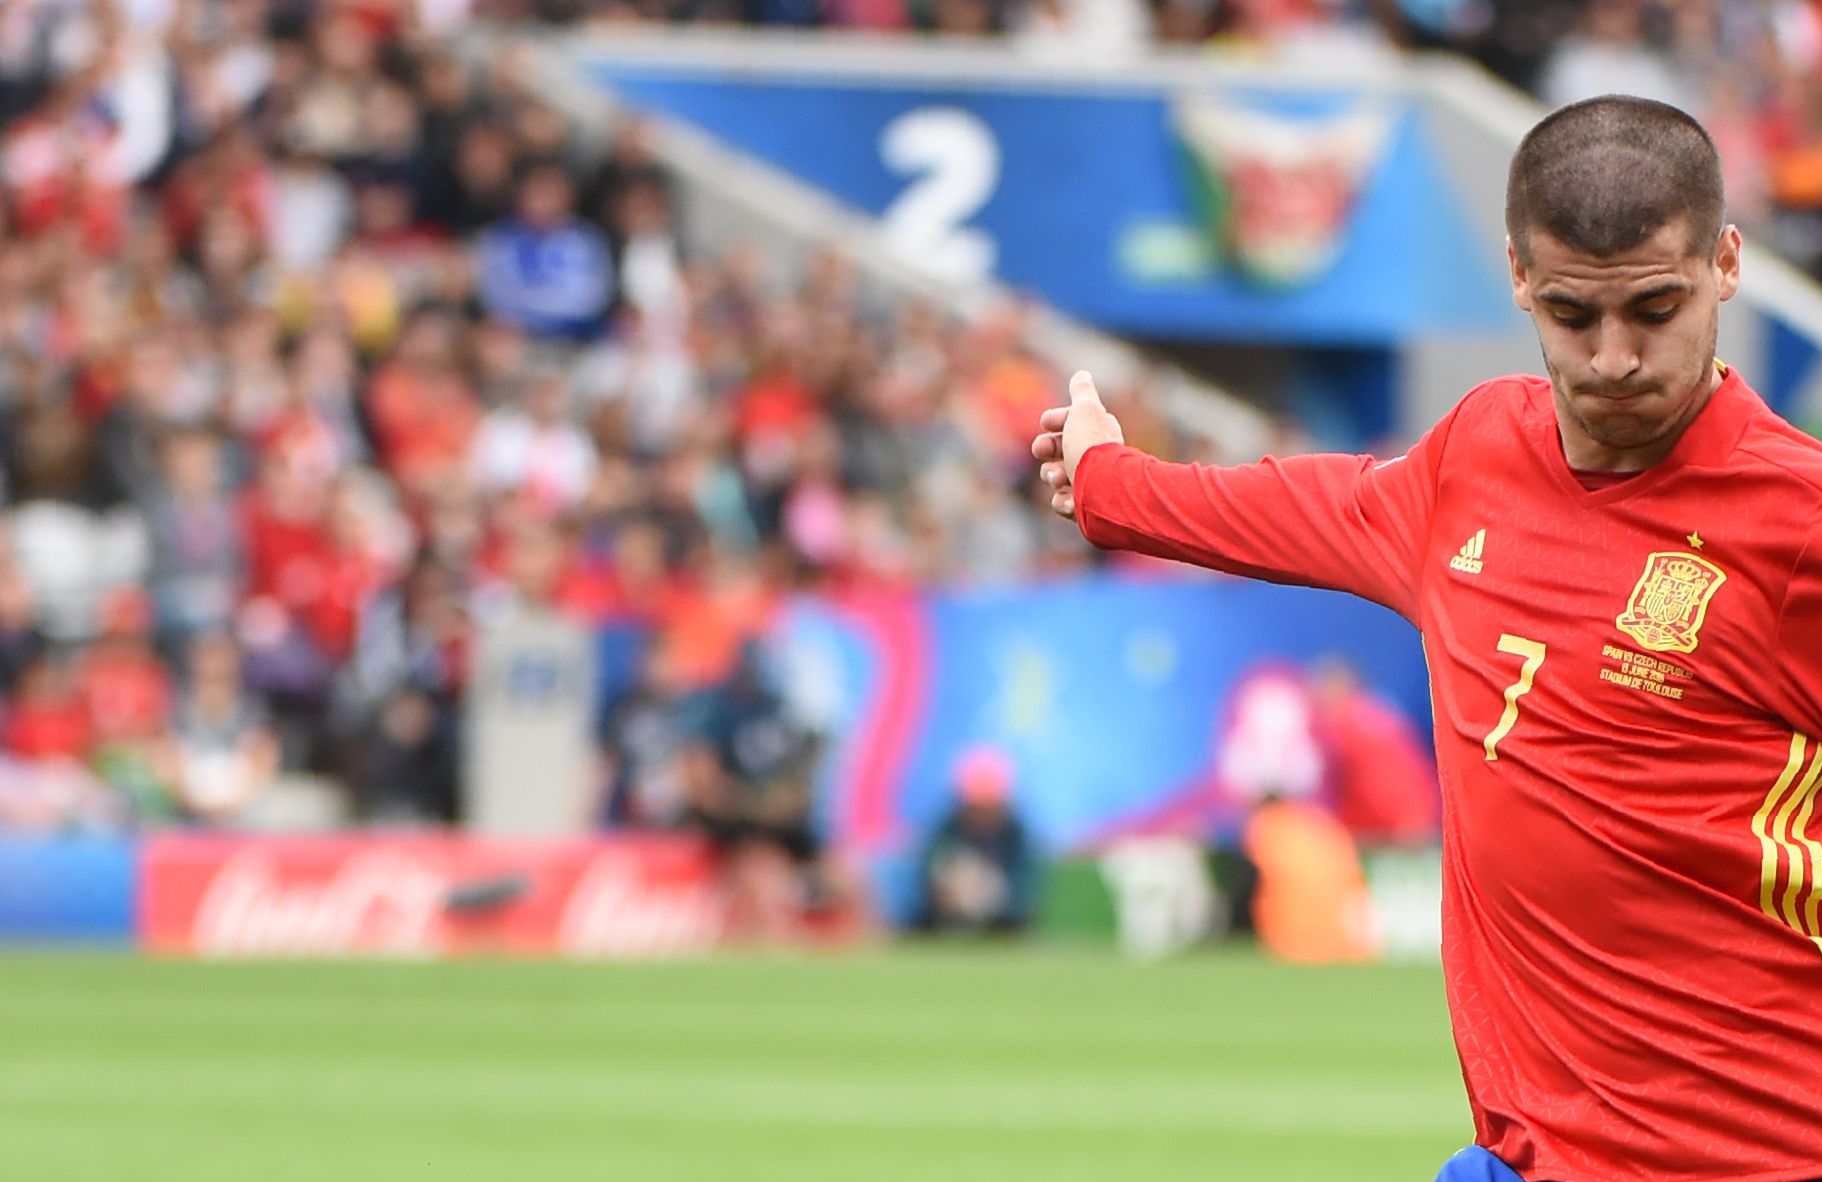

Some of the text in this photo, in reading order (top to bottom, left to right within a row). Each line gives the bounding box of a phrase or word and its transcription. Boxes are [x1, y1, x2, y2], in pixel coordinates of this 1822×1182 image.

[880, 105, 1001, 284] 2
[1450, 554, 1484, 574] adidas
[1602, 645, 1624, 660] SPAIN
[1634, 653, 1658, 669] CZECH
[1600, 669, 1684, 700] STADIUM DE TOULOUSE
[1629, 665, 1649, 678] JUNE
[1484, 633, 1546, 760] 7
